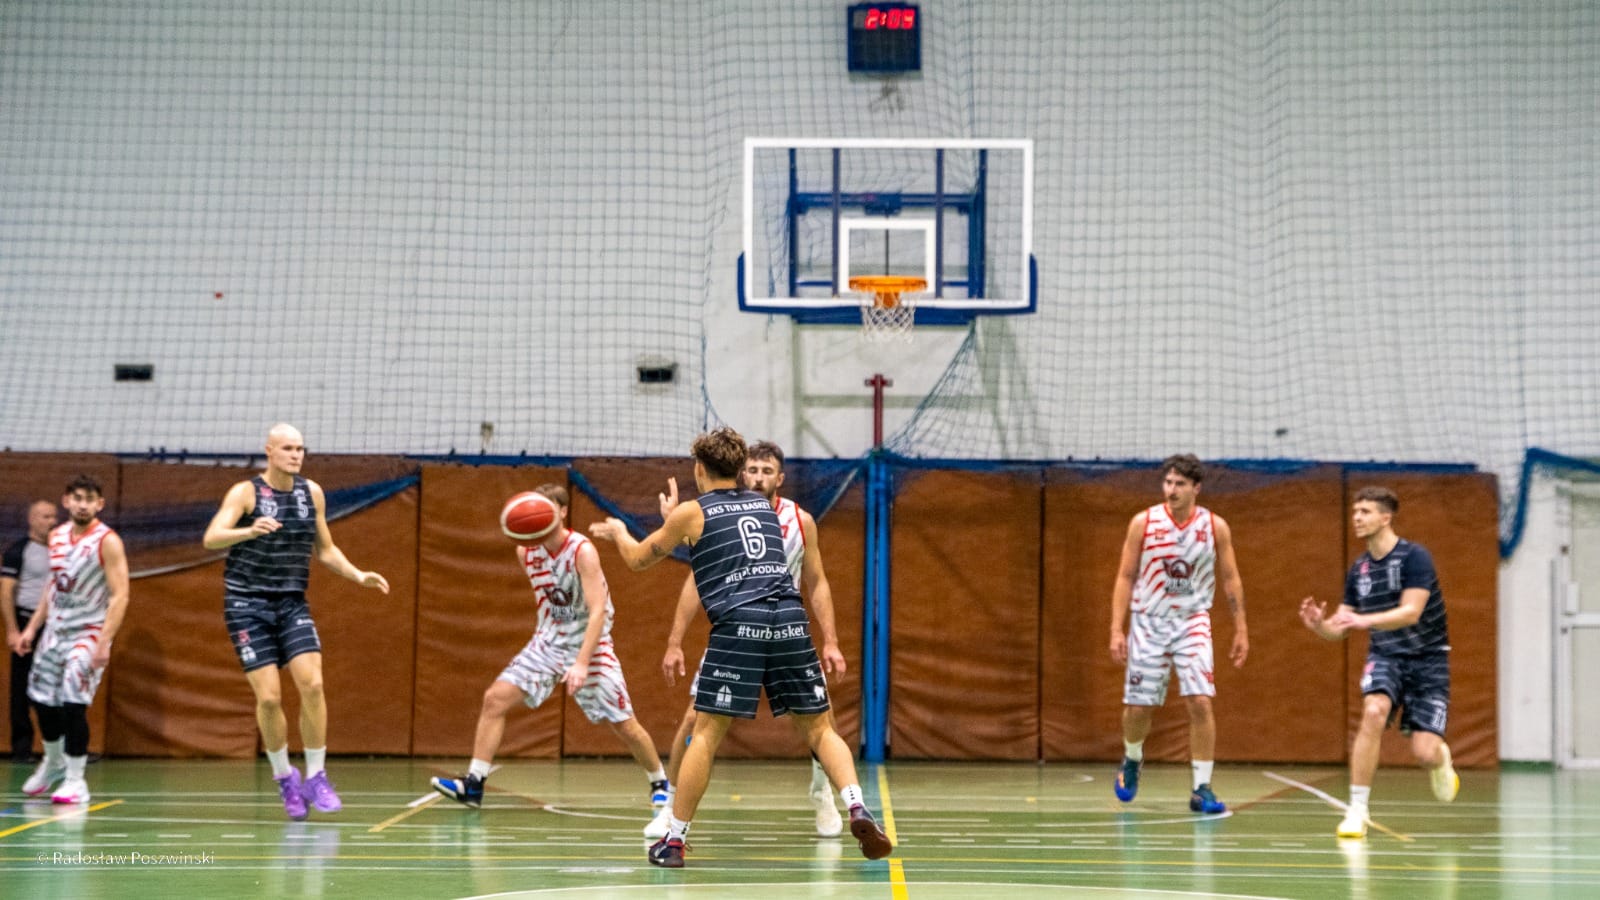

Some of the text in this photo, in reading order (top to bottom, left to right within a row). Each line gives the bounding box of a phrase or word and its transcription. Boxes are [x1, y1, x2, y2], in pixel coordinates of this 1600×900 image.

[707, 501, 771, 516] KKS TUR BASKET
[737, 515, 767, 560] 6
[737, 625, 805, 640] #turbasket
